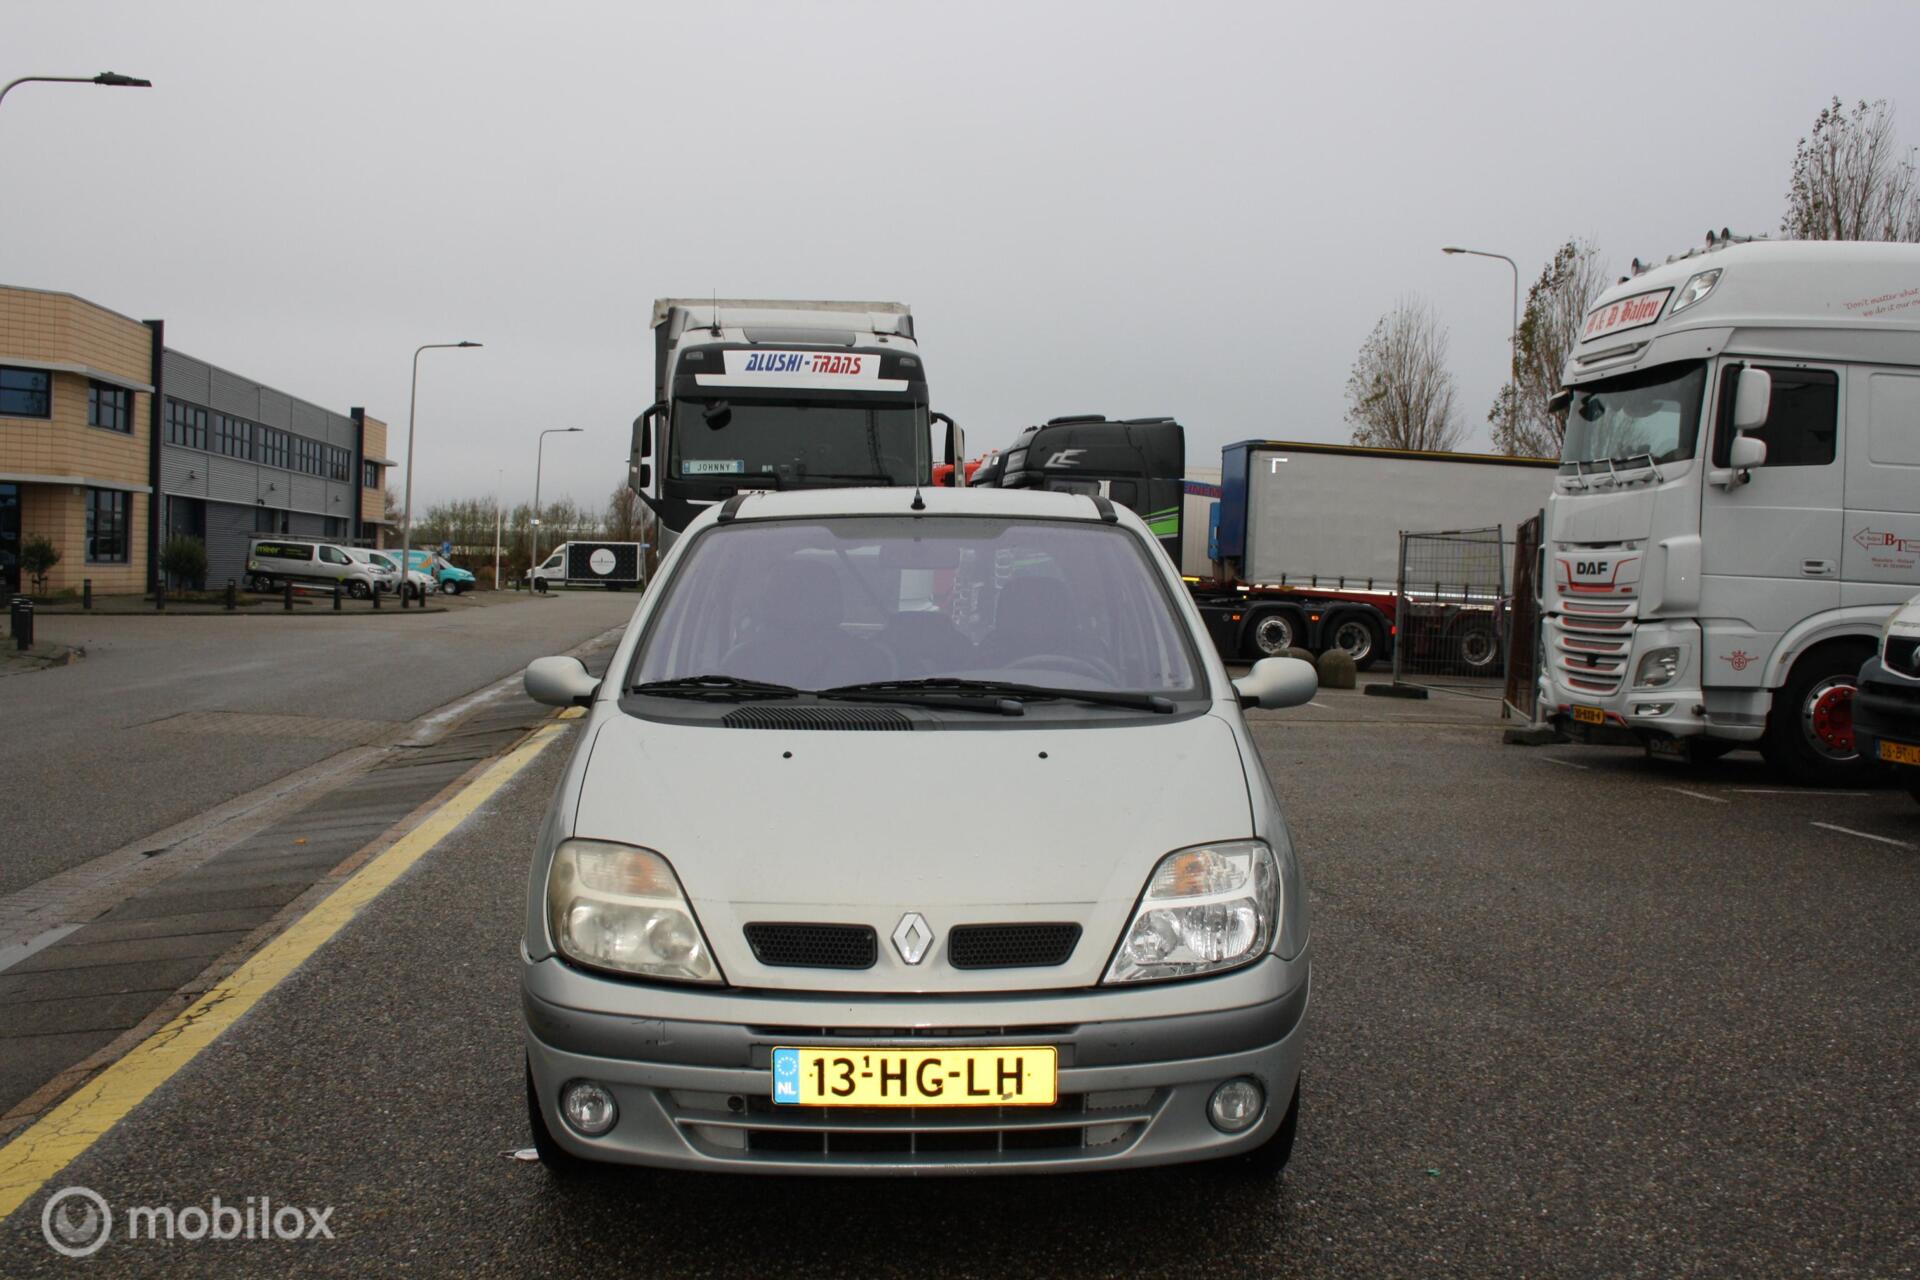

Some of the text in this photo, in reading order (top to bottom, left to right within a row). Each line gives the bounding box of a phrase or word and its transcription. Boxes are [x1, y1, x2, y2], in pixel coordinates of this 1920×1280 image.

[697, 463, 730, 472] JOHNNY
[1576, 562, 1608, 575] DAF
[777, 1083, 797, 1095] NL
